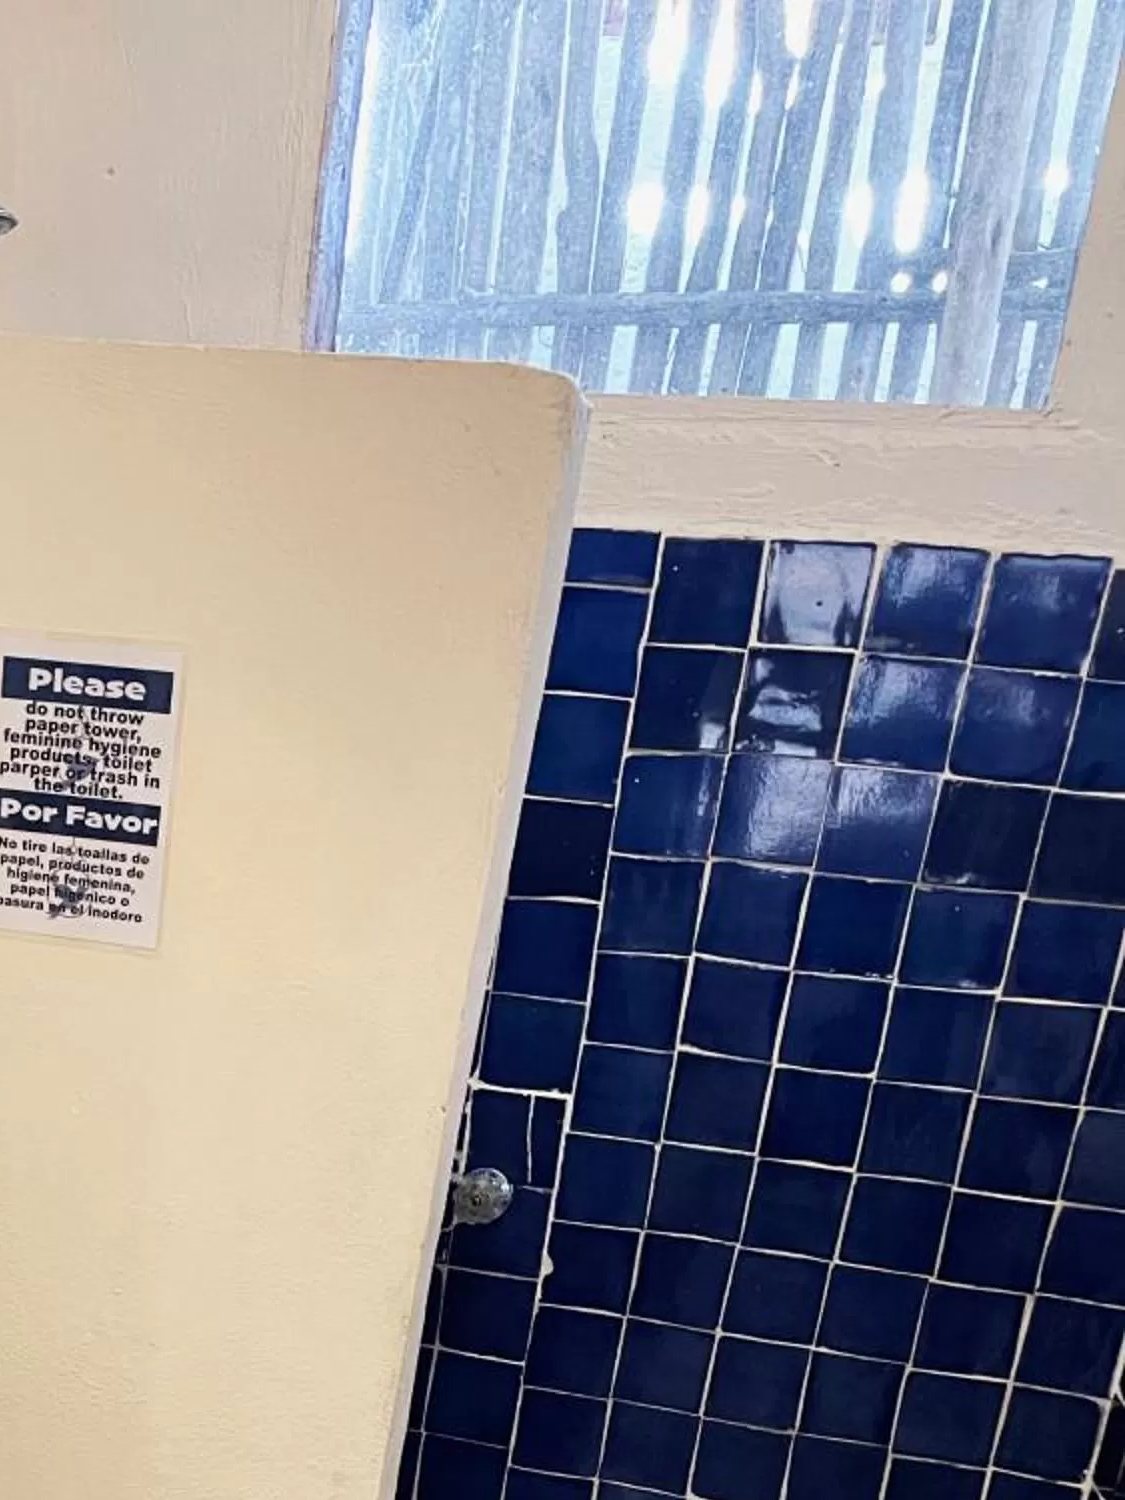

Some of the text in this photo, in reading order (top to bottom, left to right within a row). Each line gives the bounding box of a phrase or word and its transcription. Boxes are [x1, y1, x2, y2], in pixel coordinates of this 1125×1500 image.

[28, 667, 147, 701] Please
[26, 700, 144, 726] do not throw
[4, 727, 162, 759] feminine hygiene
[26, 719, 142, 743] paper tower,
[0, 761, 160, 789] parper or trash in
[103, 755, 153, 773] toilet
[34, 777, 123, 800] the toilet.
[0, 797, 158, 835] Por Favor
[22, 839, 47, 853] tire
[52, 842, 74, 856] las
[78, 846, 126, 863] toallas
[132, 852, 150, 865] de
[0, 853, 145, 879] papel, productos de
[7, 867, 59, 883] higiene
[10, 883, 50, 897] papel
[120, 897, 130, 906] o
[88, 906, 143, 923] inodoro
